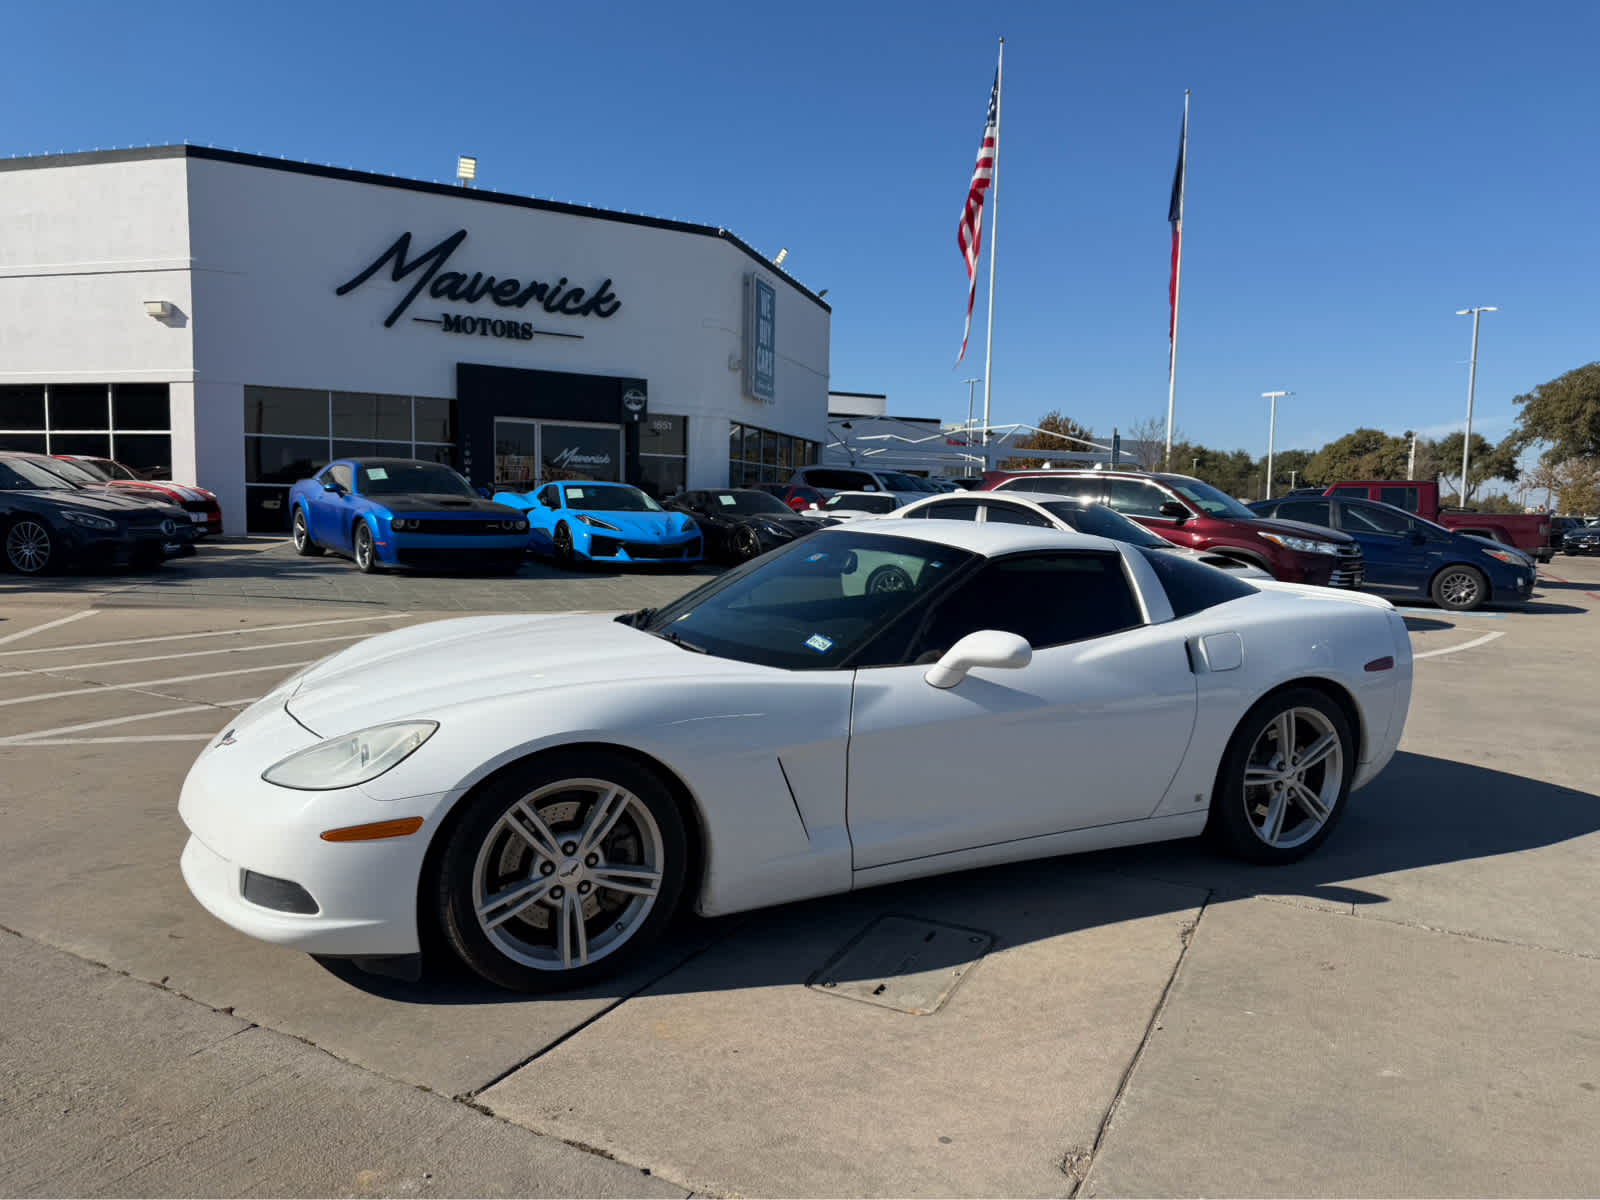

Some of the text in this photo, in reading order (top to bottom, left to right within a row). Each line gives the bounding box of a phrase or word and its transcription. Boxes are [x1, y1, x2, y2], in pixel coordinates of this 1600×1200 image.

[336, 229, 622, 328] Maverick
[442, 314, 535, 341] MOTORS
[552, 447, 611, 469] Maverick
